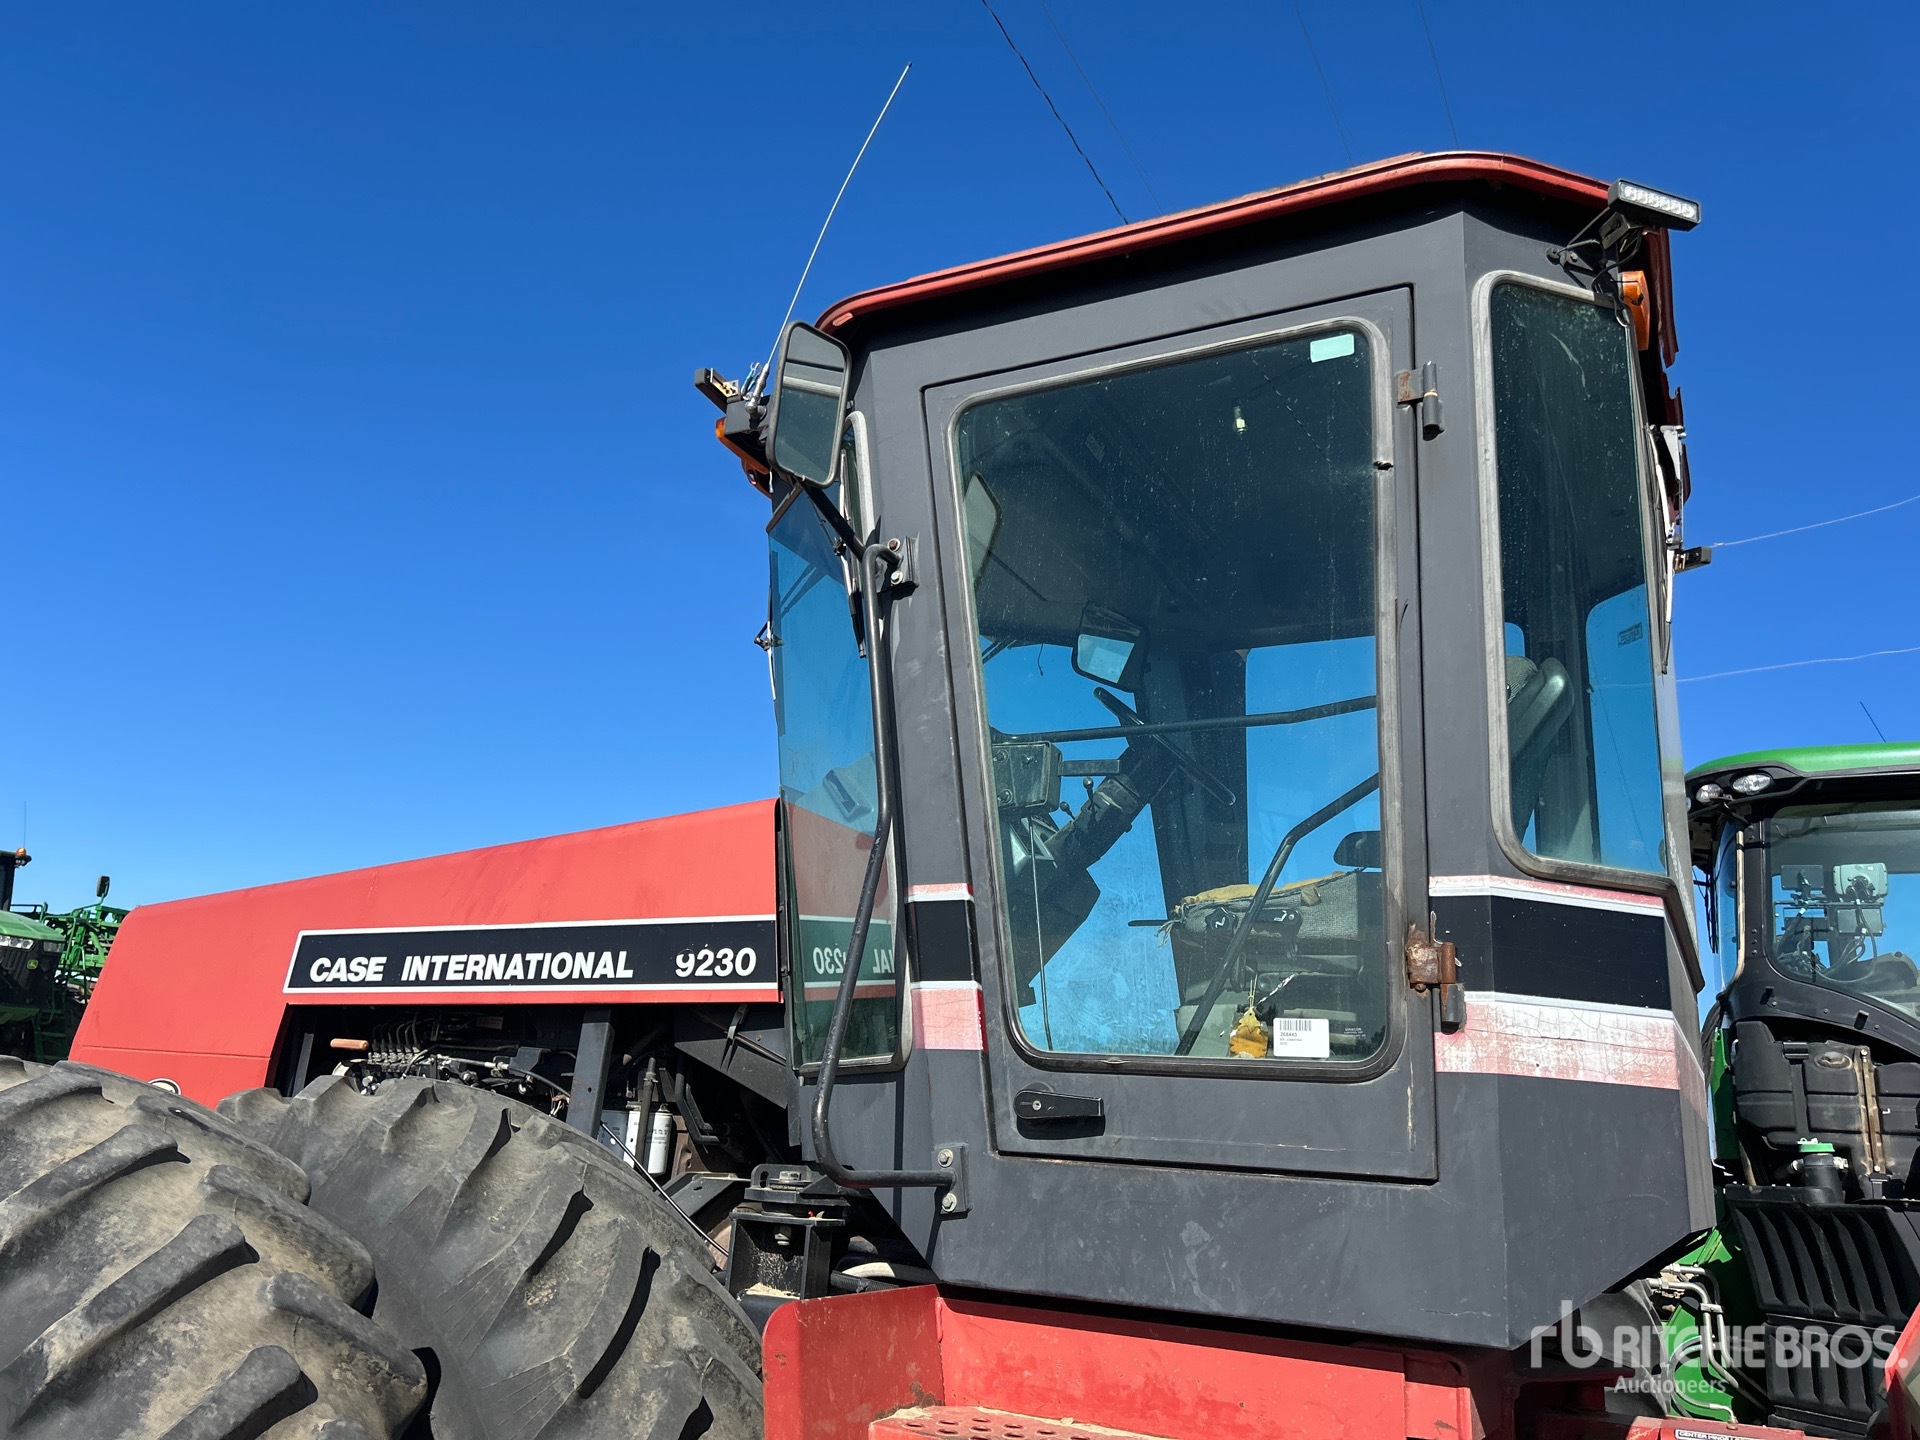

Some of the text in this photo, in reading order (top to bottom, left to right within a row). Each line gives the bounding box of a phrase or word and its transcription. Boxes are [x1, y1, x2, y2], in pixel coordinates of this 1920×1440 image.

[309, 946, 757, 983] CASE INTERNATIONAL 9230
